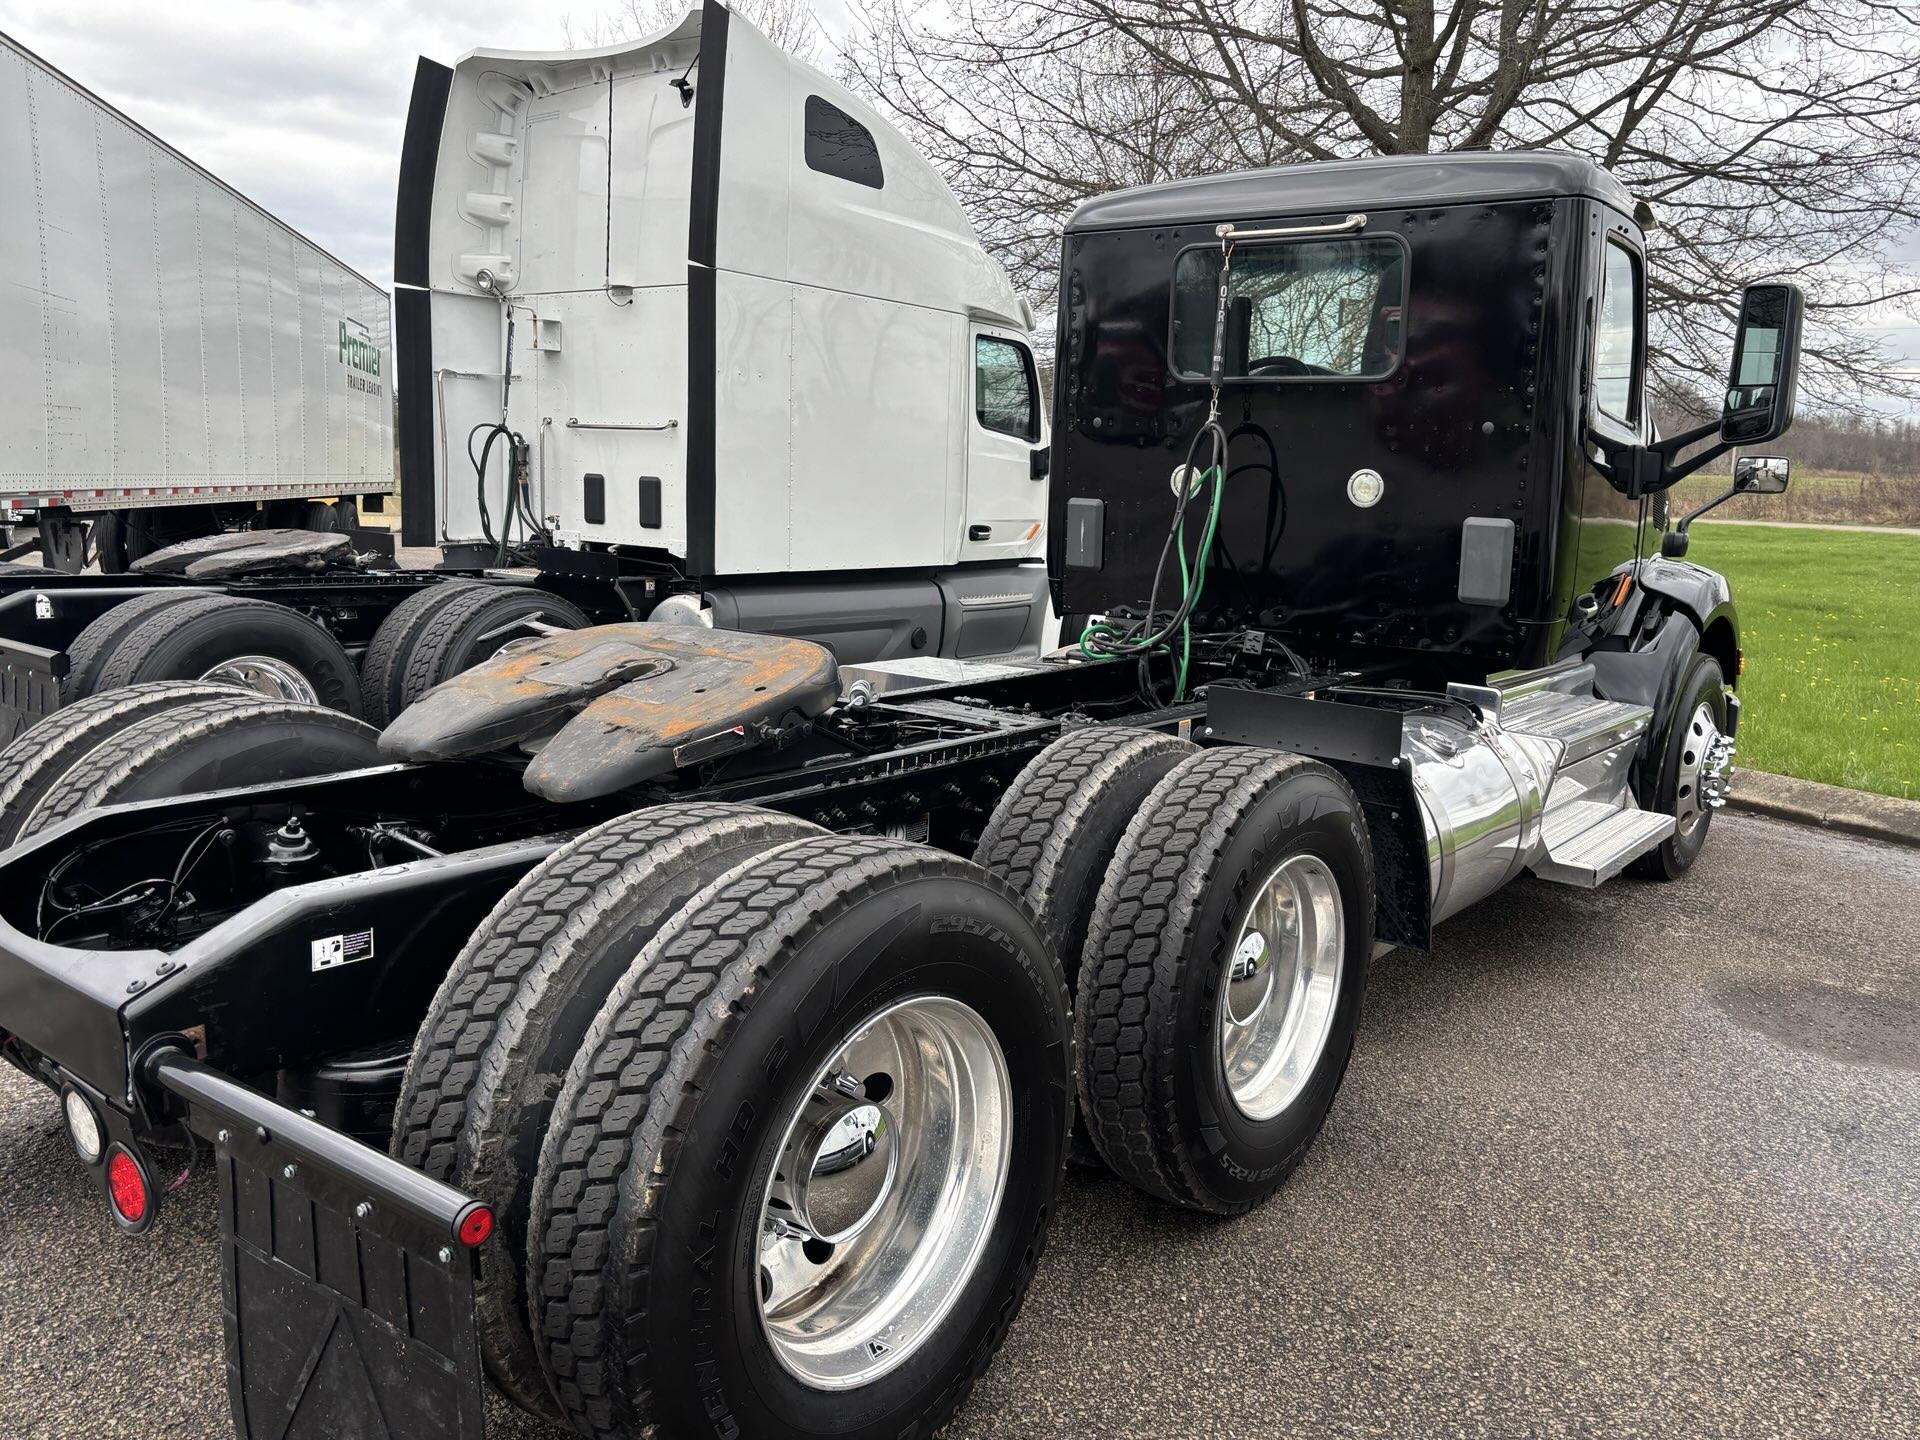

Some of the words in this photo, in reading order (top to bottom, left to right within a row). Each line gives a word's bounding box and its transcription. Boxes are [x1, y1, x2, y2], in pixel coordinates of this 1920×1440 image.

[1217, 285, 1228, 322] OTR
[338, 319, 381, 377] Premier
[347, 373, 366, 393] TRAILER
